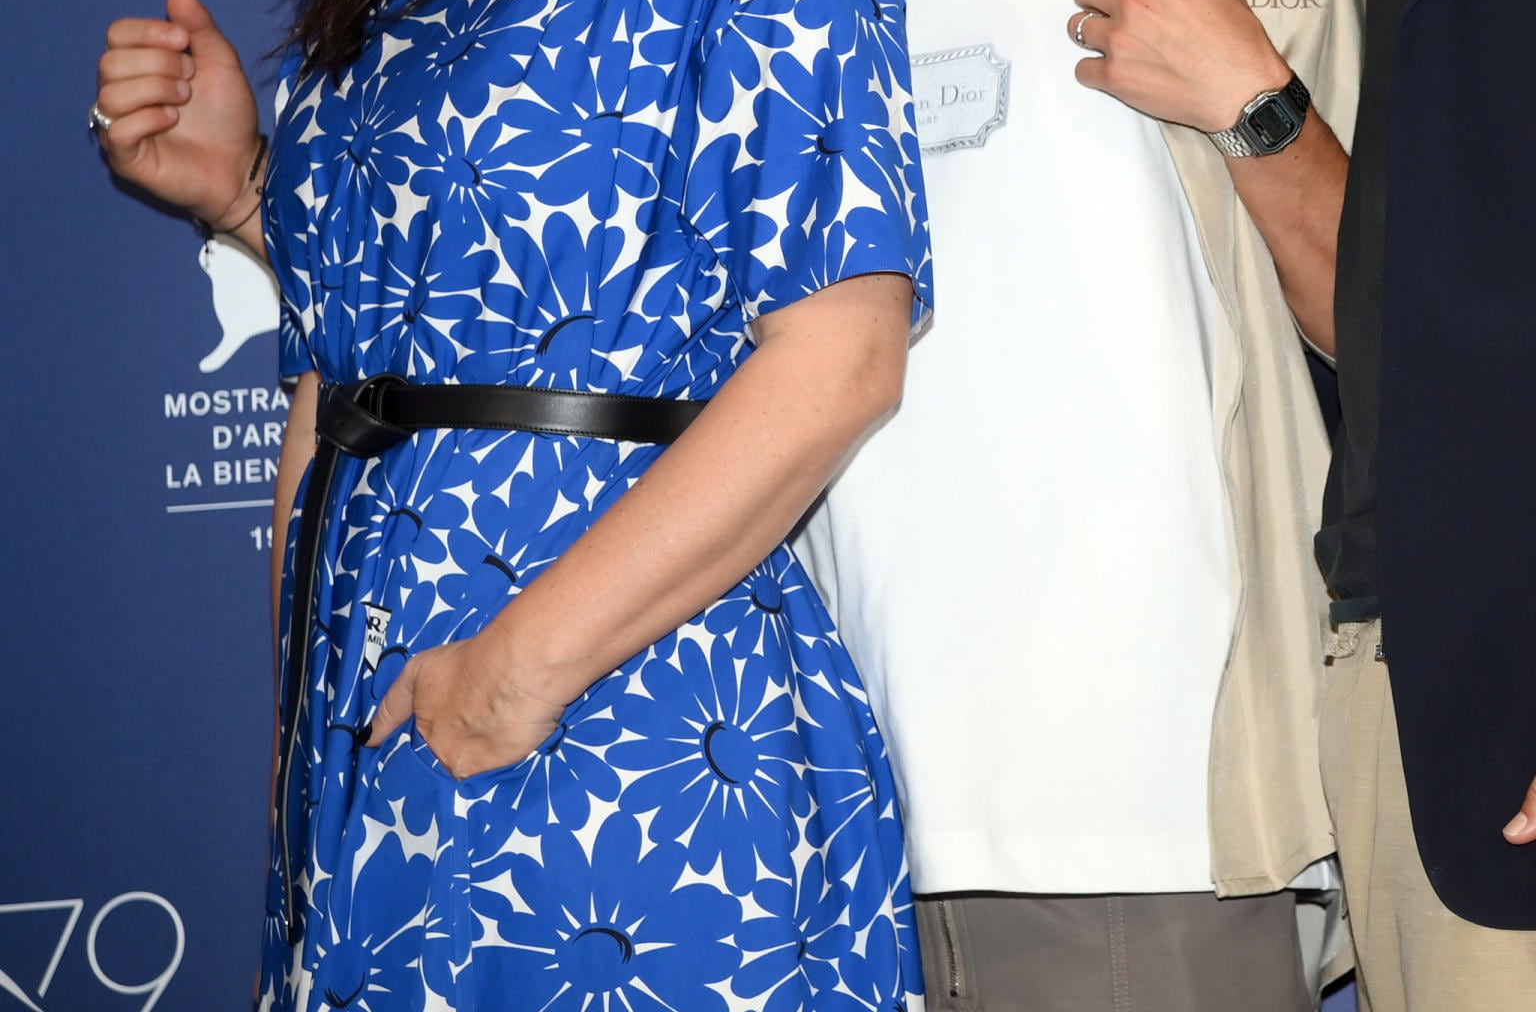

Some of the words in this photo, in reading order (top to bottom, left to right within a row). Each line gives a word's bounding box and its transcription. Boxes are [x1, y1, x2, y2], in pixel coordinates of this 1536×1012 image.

[941, 84, 987, 106] Dior
[164, 387, 291, 418] MOSTRA
[166, 463, 202, 488] LA
[0, 891, 186, 1012] 79
